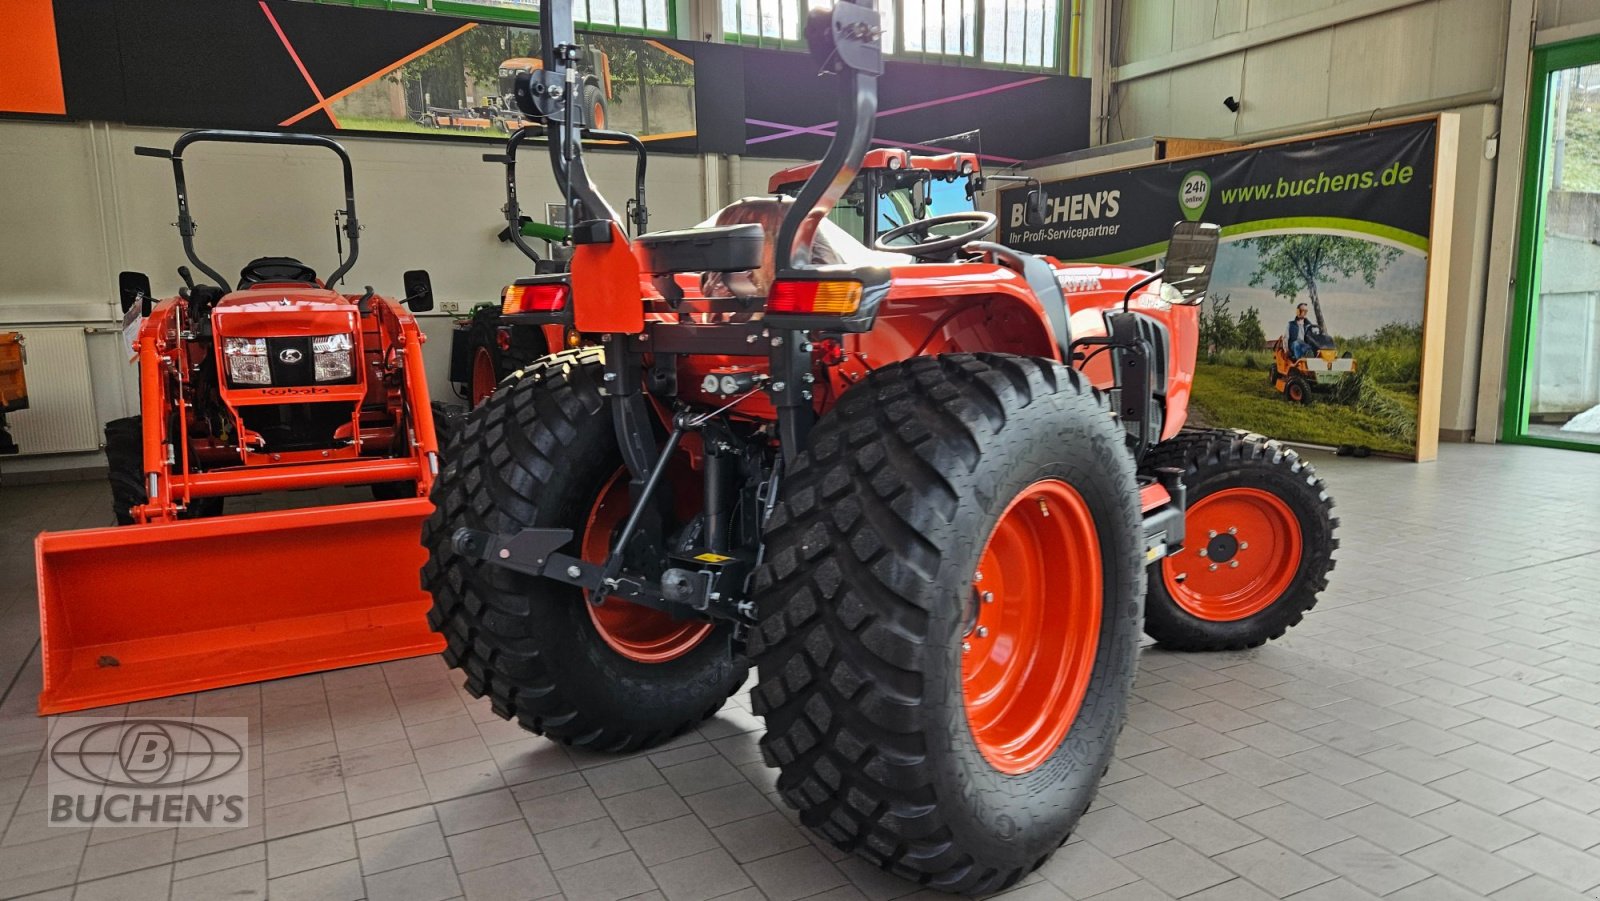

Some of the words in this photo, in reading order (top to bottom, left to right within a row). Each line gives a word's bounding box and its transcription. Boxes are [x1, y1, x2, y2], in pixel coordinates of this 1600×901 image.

[1184, 180, 1206, 194] 24h
[1221, 162, 1414, 204] www.buchens.de
[1184, 195, 1203, 203] online
[1010, 190, 1121, 227] BCHEN'S
[1009, 231, 1021, 244] Ihr
[1023, 224, 1120, 243] Profi-Servicepartner
[261, 387, 329, 396] Kubota
